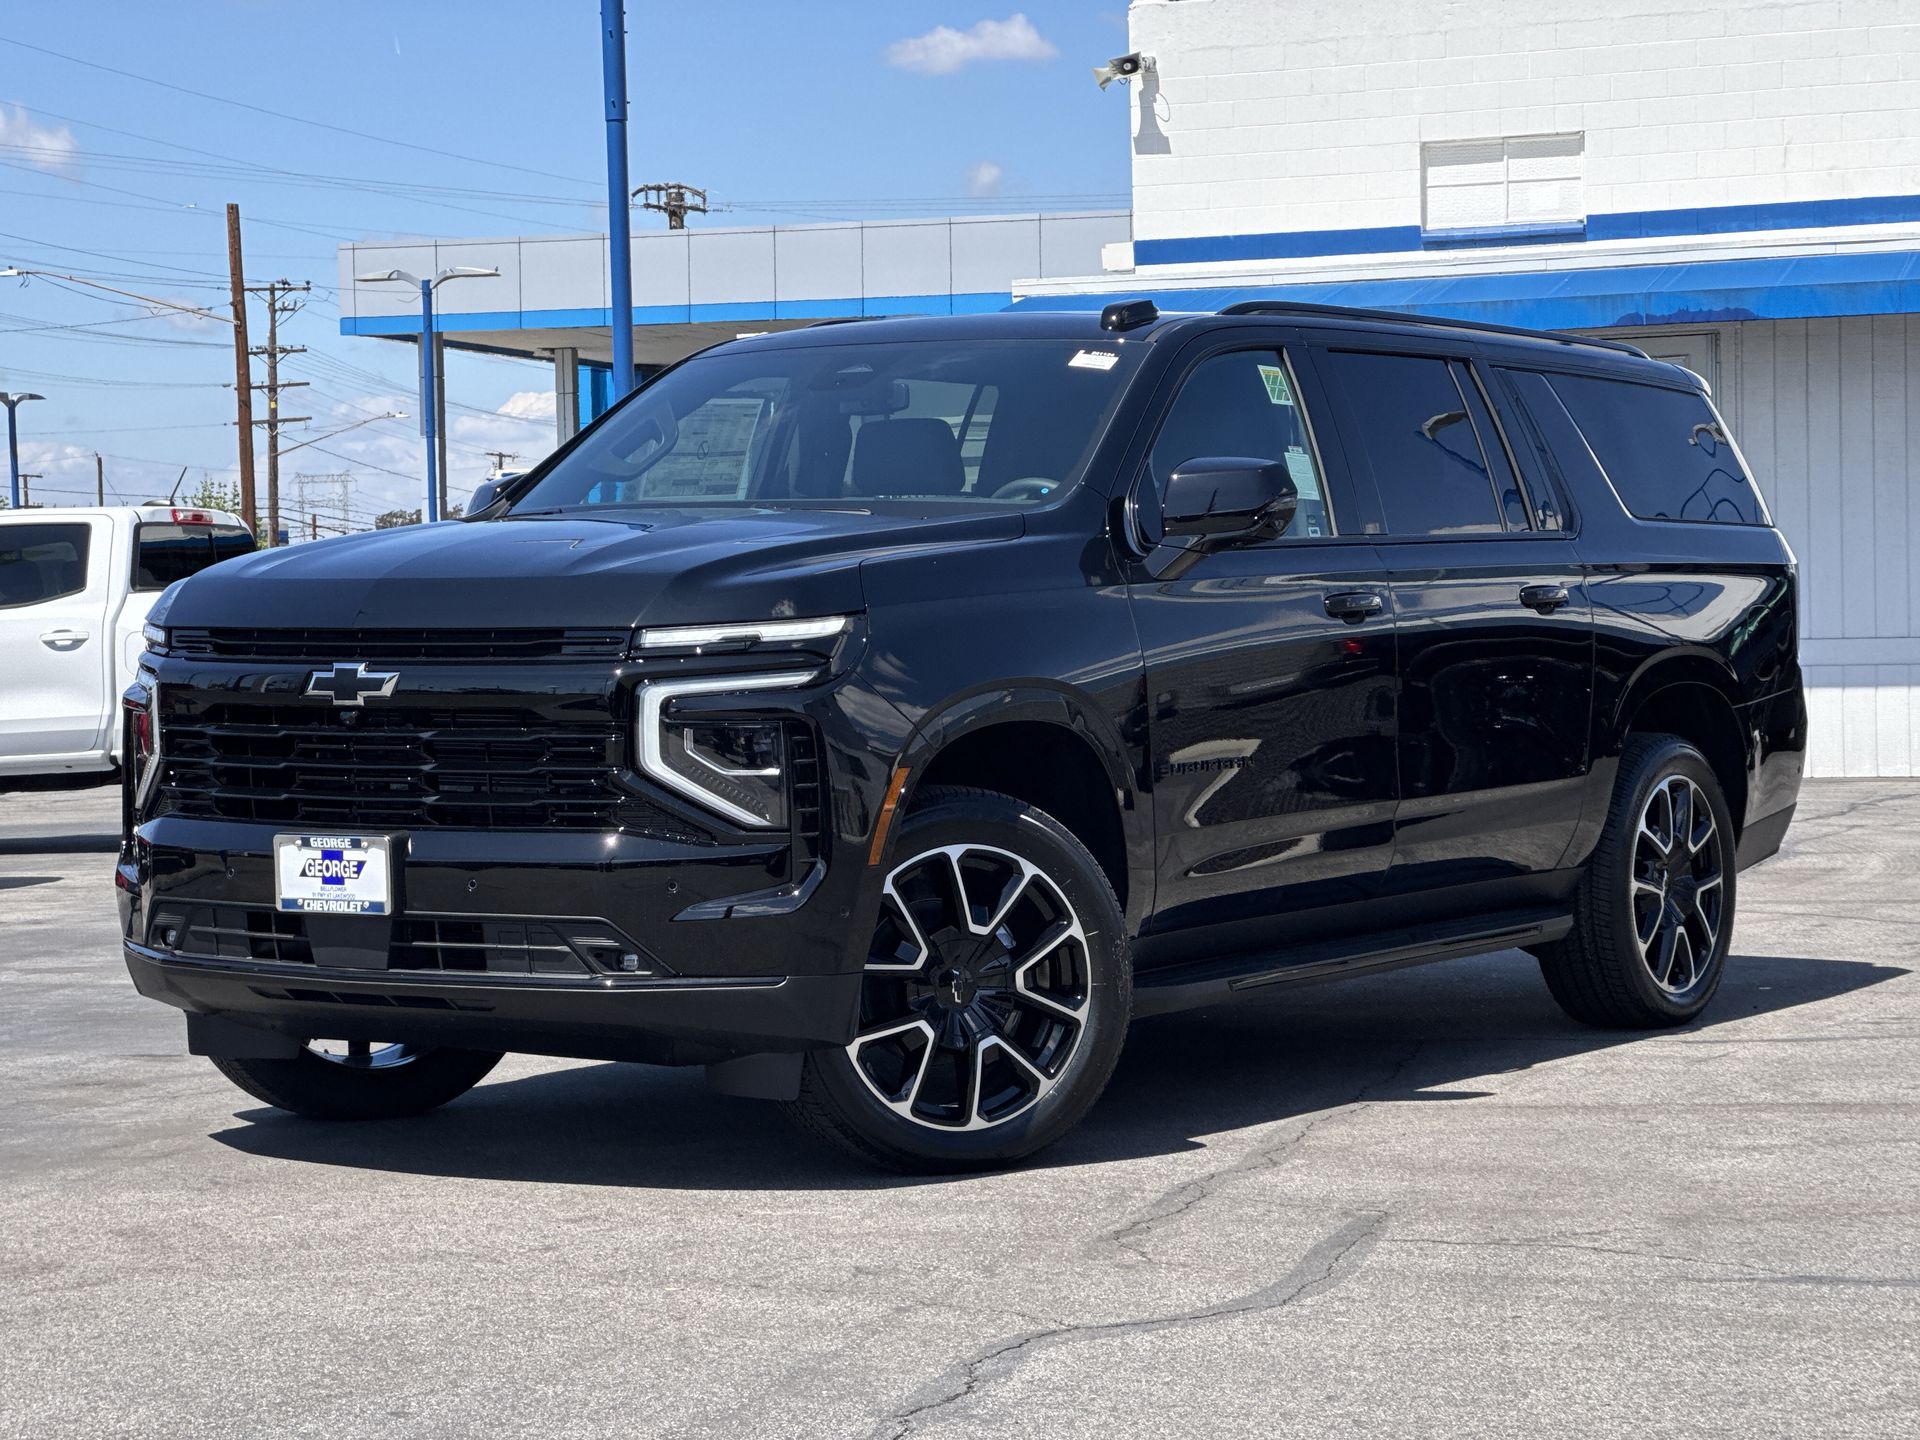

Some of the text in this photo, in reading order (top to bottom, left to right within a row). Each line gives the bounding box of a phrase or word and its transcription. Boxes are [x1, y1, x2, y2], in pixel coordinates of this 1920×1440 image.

[310, 837, 352, 849] GEORGE
[305, 859, 358, 878] GEORGE
[304, 900, 363, 912] CHEVROLET
